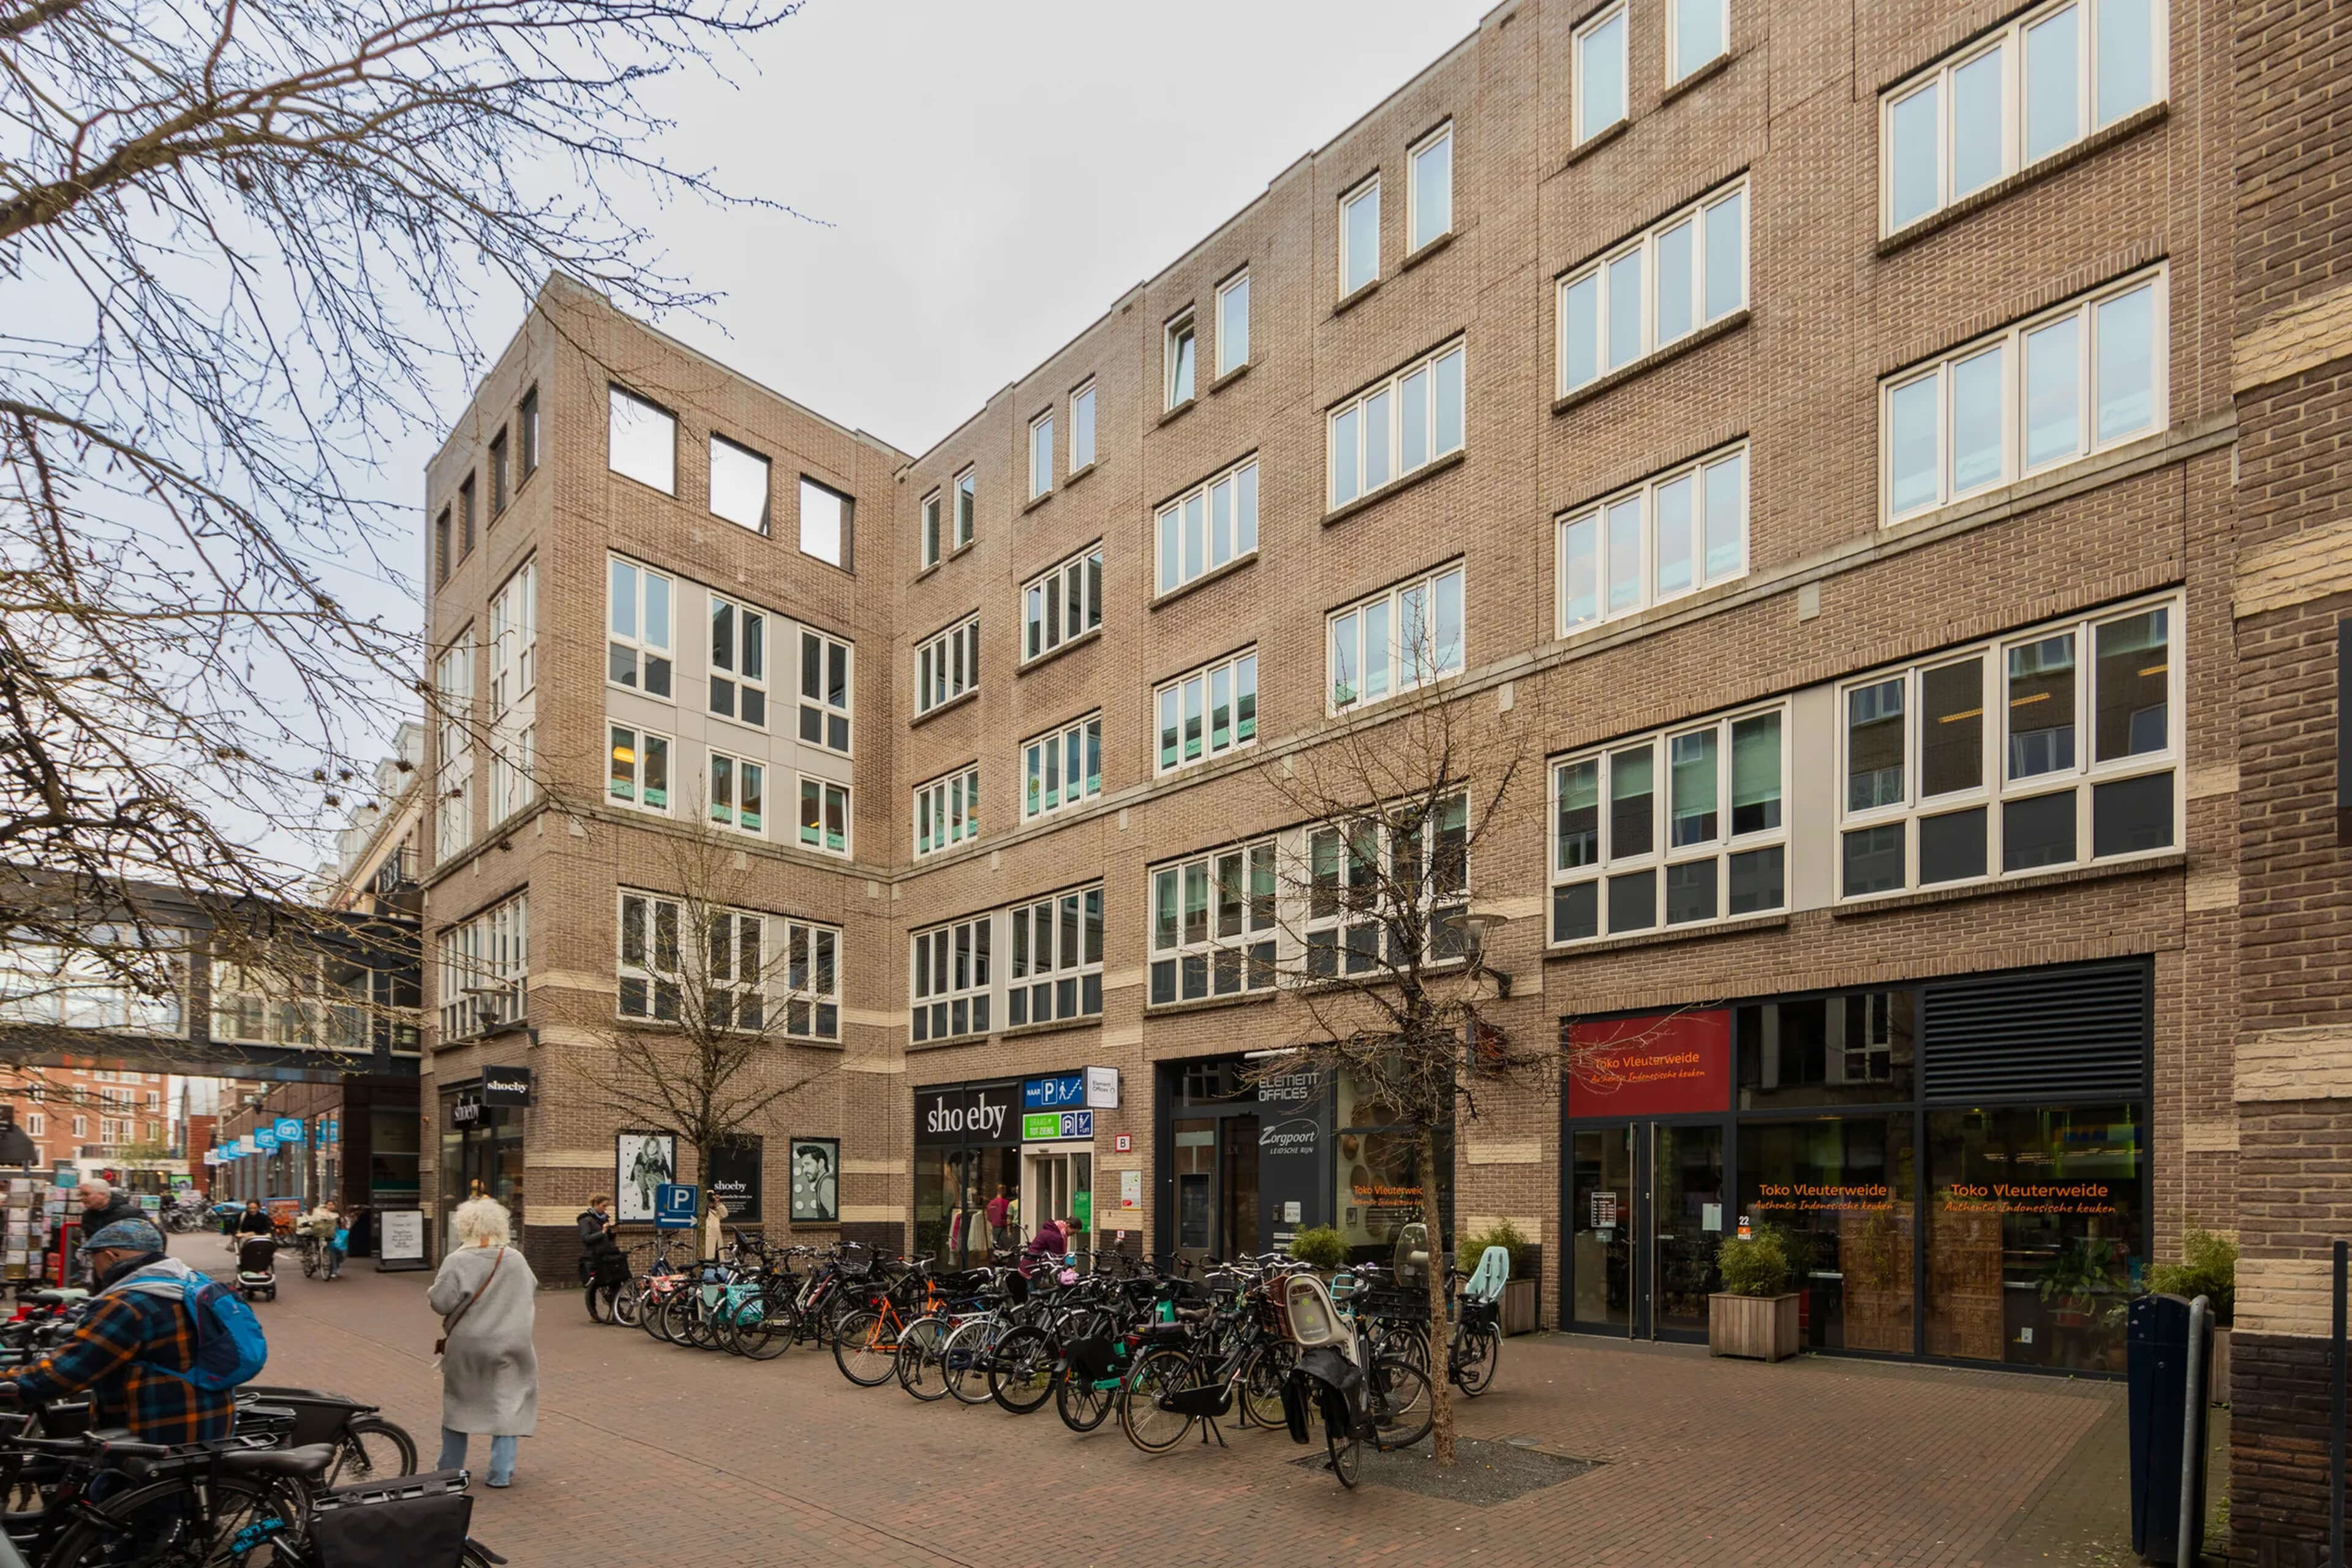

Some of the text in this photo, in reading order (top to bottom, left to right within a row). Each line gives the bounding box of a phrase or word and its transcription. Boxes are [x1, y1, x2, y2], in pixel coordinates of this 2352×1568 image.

[1596, 1052, 1700, 1069] Toko Vleuterweide
[1678, 1068, 1705, 1078] keuken
[487, 1080, 528, 1093] shoeby
[1259, 1087, 1308, 1101] OFFICES
[454, 1096, 480, 1125] shoeby
[1259, 1125, 1316, 1147] Zorgpoort
[1120, 1138, 1126, 1148] B
[1270, 1147, 1299, 1155] LEIDSCHE
[714, 1180, 747, 1192] shoeby
[1354, 1185, 1372, 1195] Toko
[1758, 1183, 1887, 1196] Toko Vleuterweide
[1951, 1183, 2108, 1197] Toko Vleuterweide
[674, 1189, 690, 1209] P
[1754, 1200, 1893, 1211] Authentic Indonesische keuken
[1943, 1200, 2116, 1213] Authentic Indonesische keuken
[1739, 1216, 1749, 1226] 22
